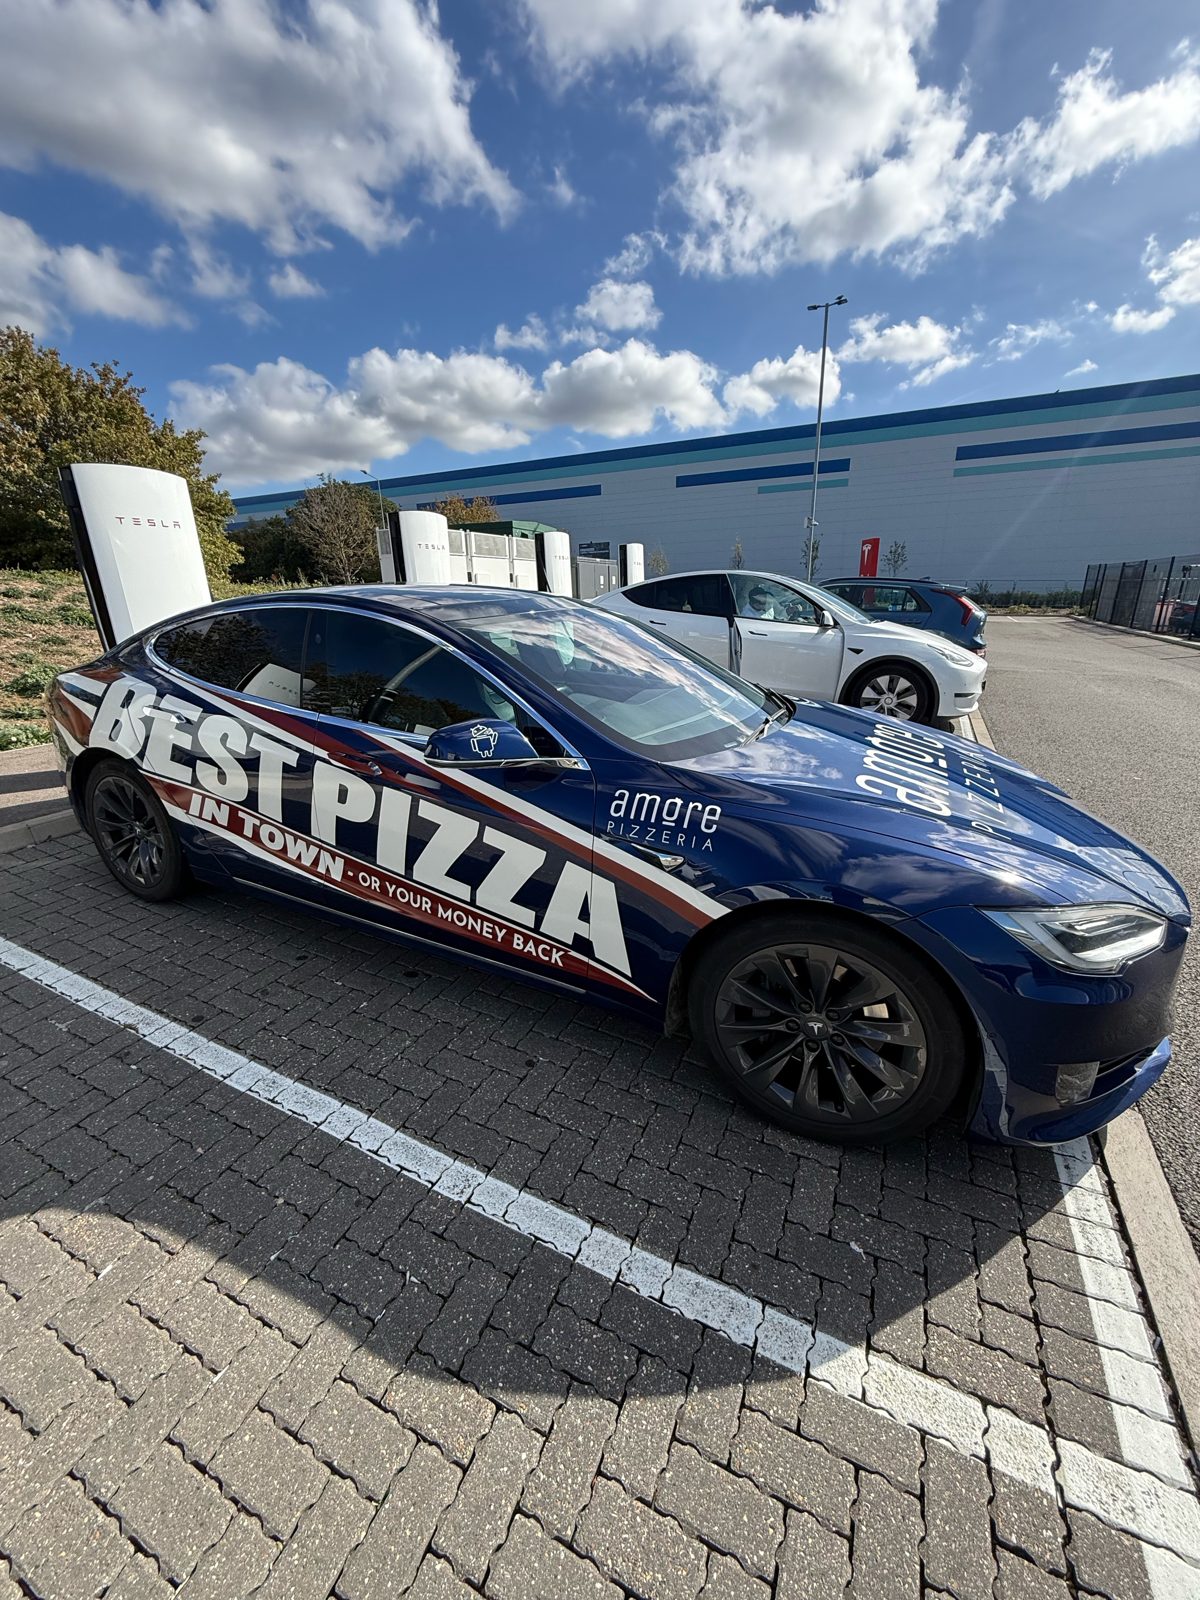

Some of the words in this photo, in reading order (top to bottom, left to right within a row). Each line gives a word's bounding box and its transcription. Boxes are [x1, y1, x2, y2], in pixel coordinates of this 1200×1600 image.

[115, 516, 182, 529] TESLA
[417, 543, 446, 551] TESLA
[855, 723, 952, 816] amore
[89, 676, 299, 823] BEST
[310, 760, 632, 978] PIZZA
[609, 789, 722, 833] amore
[606, 820, 713, 851] PIZZERIA
[188, 793, 231, 828] IN
[238, 806, 345, 882] TOWN
[358, 871, 381, 894] OR
[385, 881, 432, 914] YOUR
[437, 903, 508, 943] MONEY
[512, 933, 565, 967] BACK
